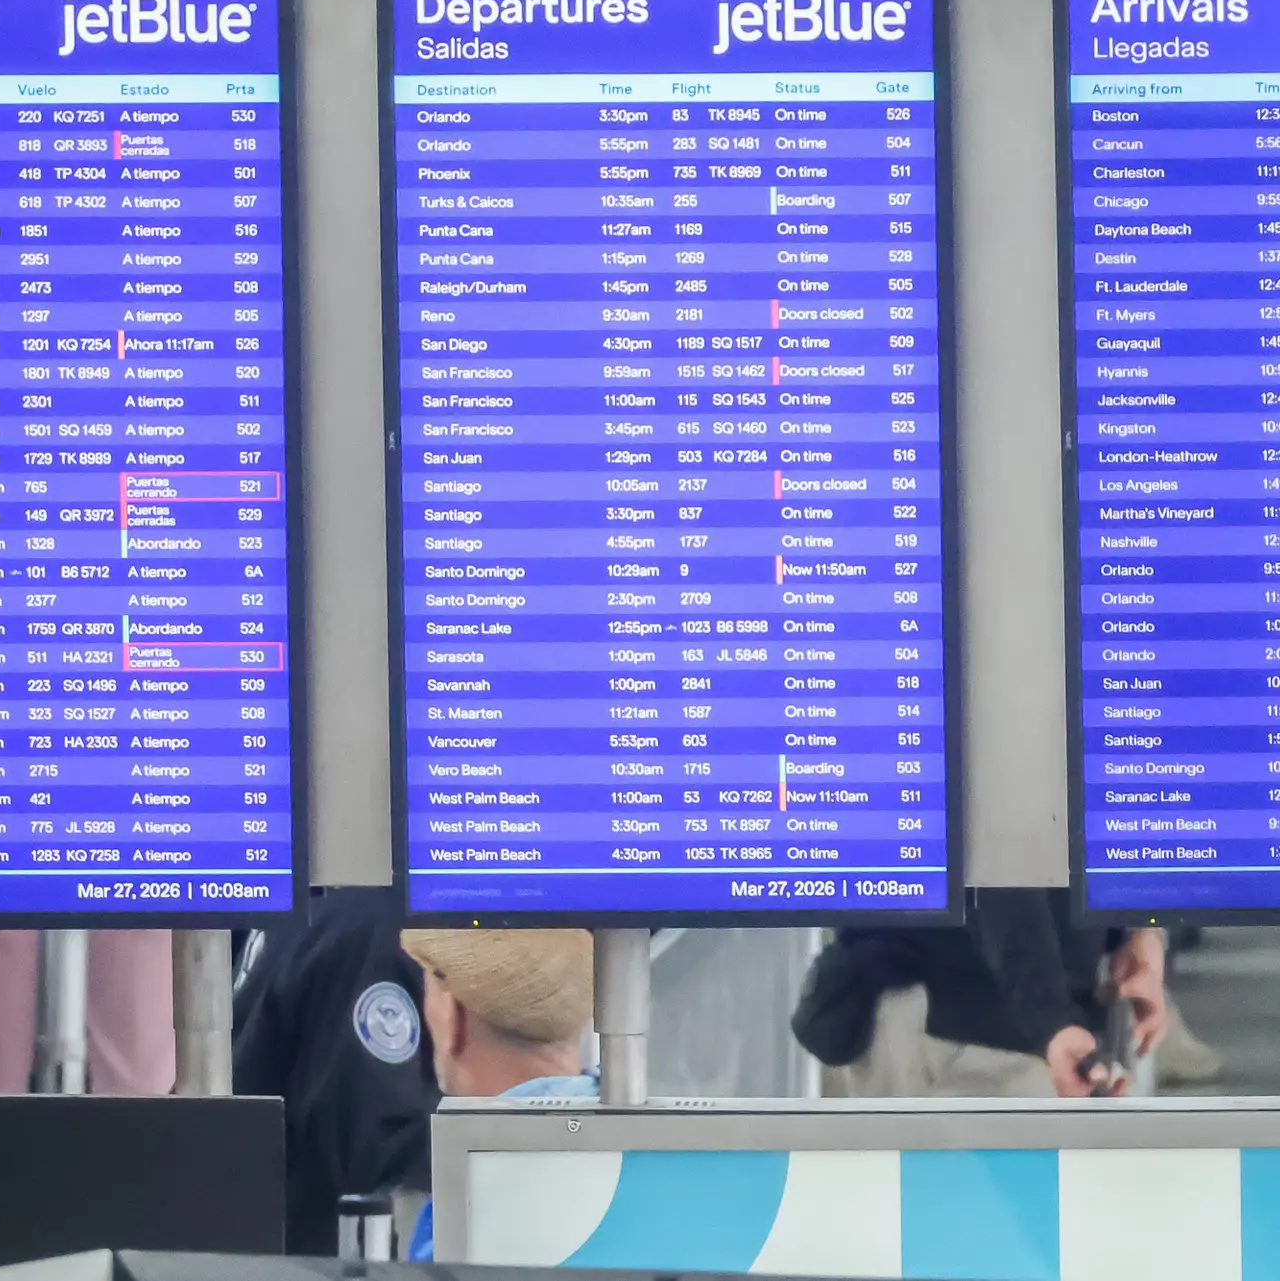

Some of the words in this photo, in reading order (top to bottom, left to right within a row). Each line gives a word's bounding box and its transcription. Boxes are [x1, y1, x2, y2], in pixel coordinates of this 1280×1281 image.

[417, 37, 509, 59] Salidas
[1094, 36, 1209, 64] Llegadas
[18, 84, 56, 96] Vuelo
[121, 84, 169, 96] Estado
[226, 83, 255, 95] Prta
[417, 84, 496, 96] Destination
[599, 83, 632, 95] Time
[672, 82, 711, 98] Flight
[775, 82, 820, 94] Status
[876, 81, 910, 93] Gate
[1092, 84, 1146, 98] Arriving
[1150, 83, 1182, 95] from
[18, 110, 42, 123] 220
[54, 110, 75, 123] KQ
[76, 110, 104, 123] 7251
[120, 110, 131, 122] A
[132, 110, 179, 125] tiempo
[231, 110, 256, 122] 530
[1092, 110, 1139, 122] Boston
[421, 338, 446, 351] San
[449, 338, 488, 354] Diego
[602, 337, 652, 352] 4:30pm
[676, 336, 705, 349] 1189
[712, 336, 733, 349] SQ
[735, 336, 762, 349] 1517
[778, 336, 799, 348] On
[801, 336, 830, 348] time
[890, 335, 914, 348] 509
[1096, 337, 1160, 352] Guayaquil
[27, 679, 51, 692] 223
[63, 679, 84, 692] SQ
[86, 679, 117, 692] 1496
[129, 679, 141, 691] A
[142, 680, 189, 694] tiempo
[240, 678, 265, 691] 509
[78, 883, 111, 898] Mar
[114, 883, 136, 900] 27,
[140, 882, 180, 898] 2026
[200, 882, 269, 898] 10:08am
[732, 881, 765, 896] Mar
[768, 881, 790, 898] 27,
[794, 880, 835, 896] 2026
[854, 880, 924, 896] 10:08am
